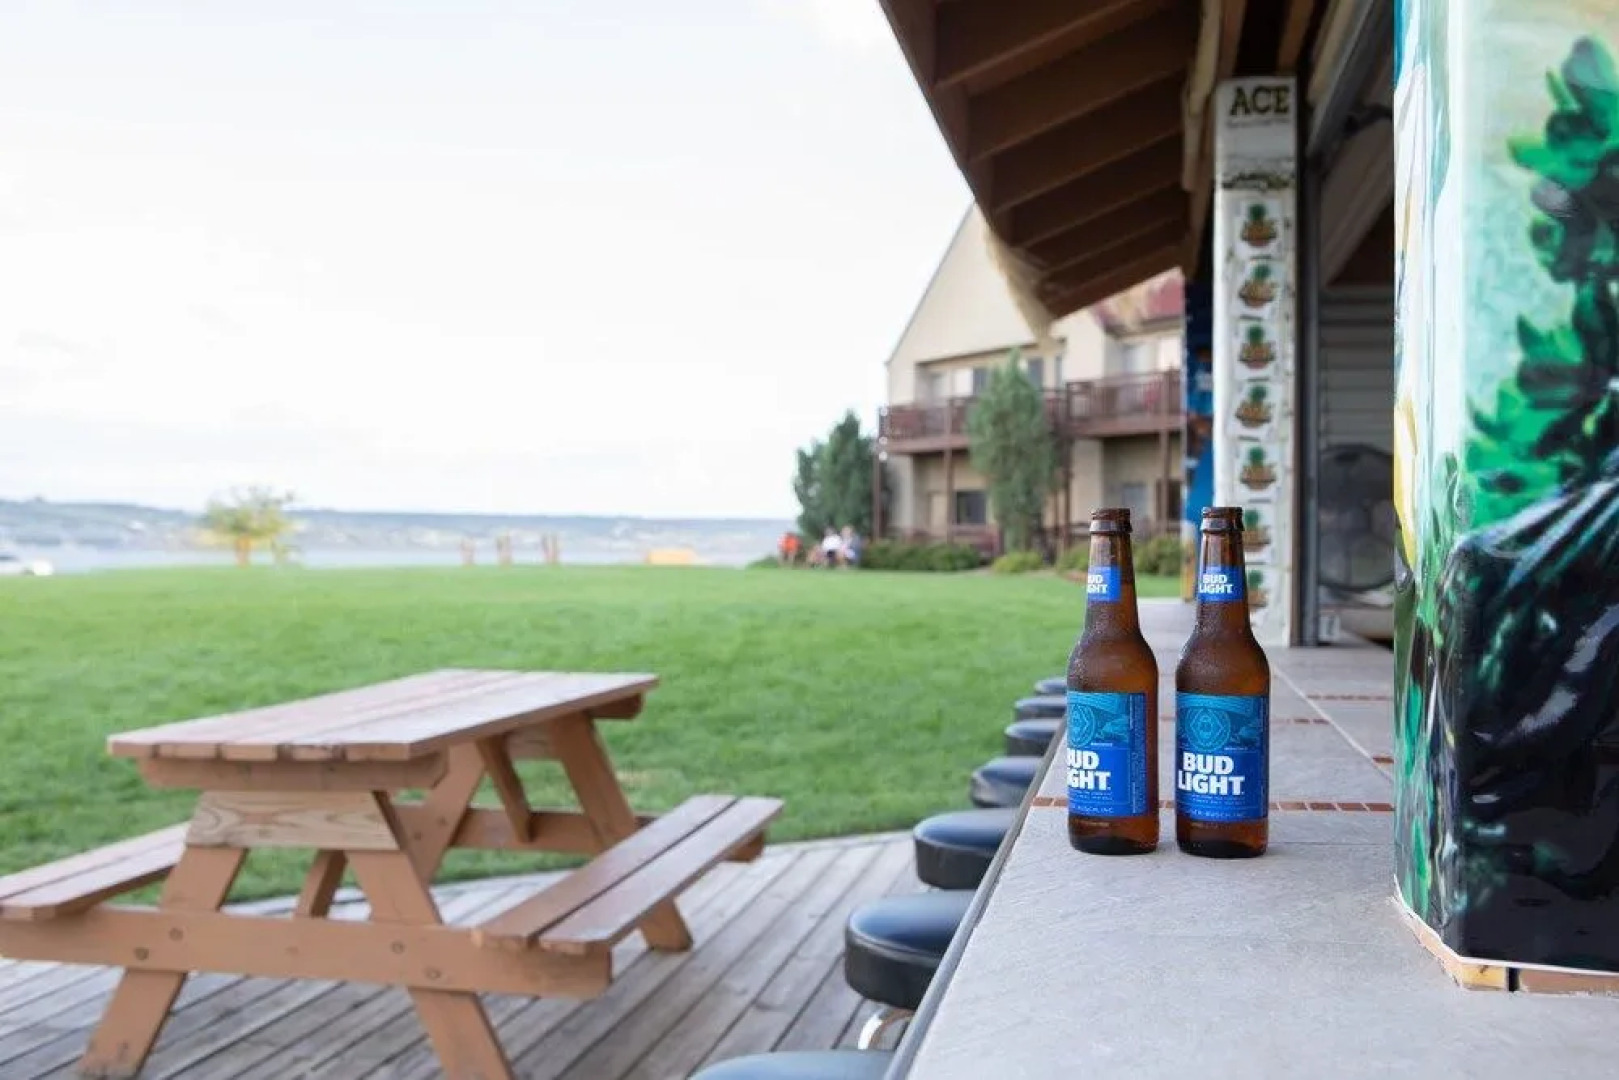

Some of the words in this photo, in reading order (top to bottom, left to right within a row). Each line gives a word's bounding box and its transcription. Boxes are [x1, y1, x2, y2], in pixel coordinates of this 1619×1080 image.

[1230, 85, 1291, 115] ACE
[1087, 574, 1103, 583] UD
[1202, 574, 1228, 584] BUD
[1087, 584, 1108, 593] GHT
[1199, 583, 1234, 594] LIGHT
[1183, 751, 1234, 775] BUD
[1066, 769, 1111, 790] GHT
[1178, 770, 1246, 795] LIGHT
